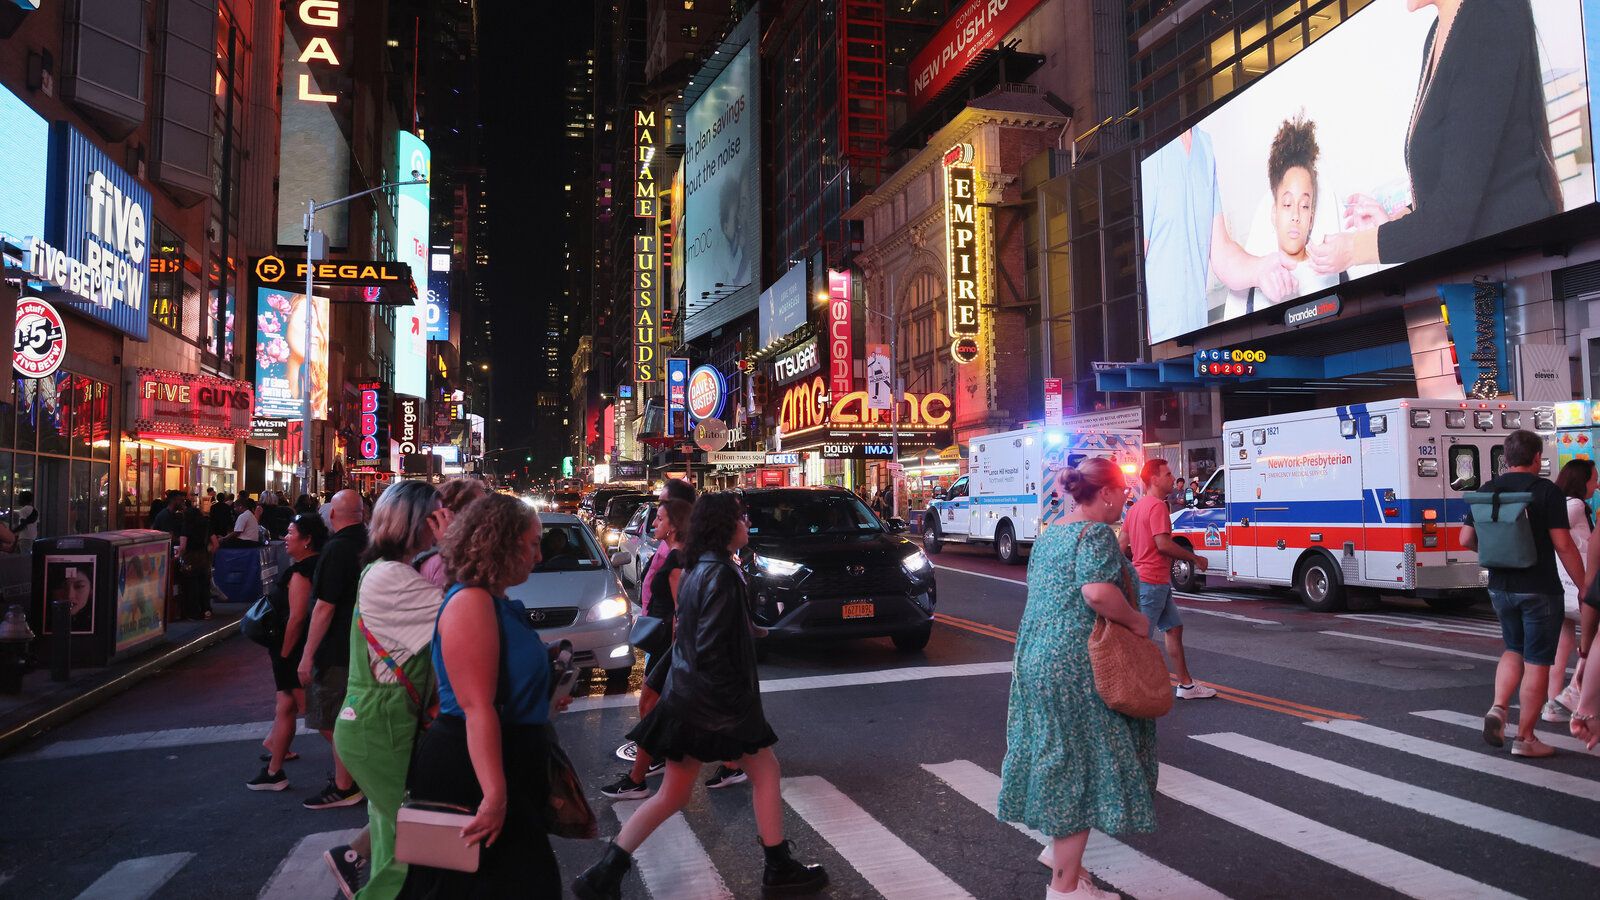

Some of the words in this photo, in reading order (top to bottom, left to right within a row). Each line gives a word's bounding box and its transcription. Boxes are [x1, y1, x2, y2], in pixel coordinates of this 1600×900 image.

[914, 55, 939, 96] NEW
[942, 9, 984, 68] PLUSH
[694, 131, 711, 162] plan
[712, 94, 745, 139] savings
[637, 110, 655, 216] MADAME
[703, 160, 716, 184] the
[717, 136, 741, 172] noise
[86, 170, 145, 264] five
[954, 178, 976, 325] EMPIRE
[29, 235, 67, 287] five
[69, 256, 114, 310] BELOW
[297, 263, 398, 280] REGAL
[25, 304, 46, 315] stuff
[638, 236, 653, 380] TUSSAUD'S
[16, 355, 37, 371] five
[38, 345, 61, 371] BELOW
[775, 343, 818, 382] IT'SUGAR
[1246, 352, 1253, 360] Q
[145, 381, 191, 403] FIVE
[198, 386, 250, 411] GUYS
[691, 380, 707, 400] DAVE
[708, 377, 714, 390] &
[257, 420, 287, 428] WESTIN
[361, 390, 378, 459] BBQ
[402, 400, 417, 441] target
[1267, 427, 1279, 435] 1821
[774, 453, 797, 464] GIFTS
[823, 445, 855, 453] DOLBY
[1267, 454, 1352, 469] NewYork-Presbyterian
[1418, 446, 1437, 455] 1821
[1005, 467, 1019, 475] Hospital
